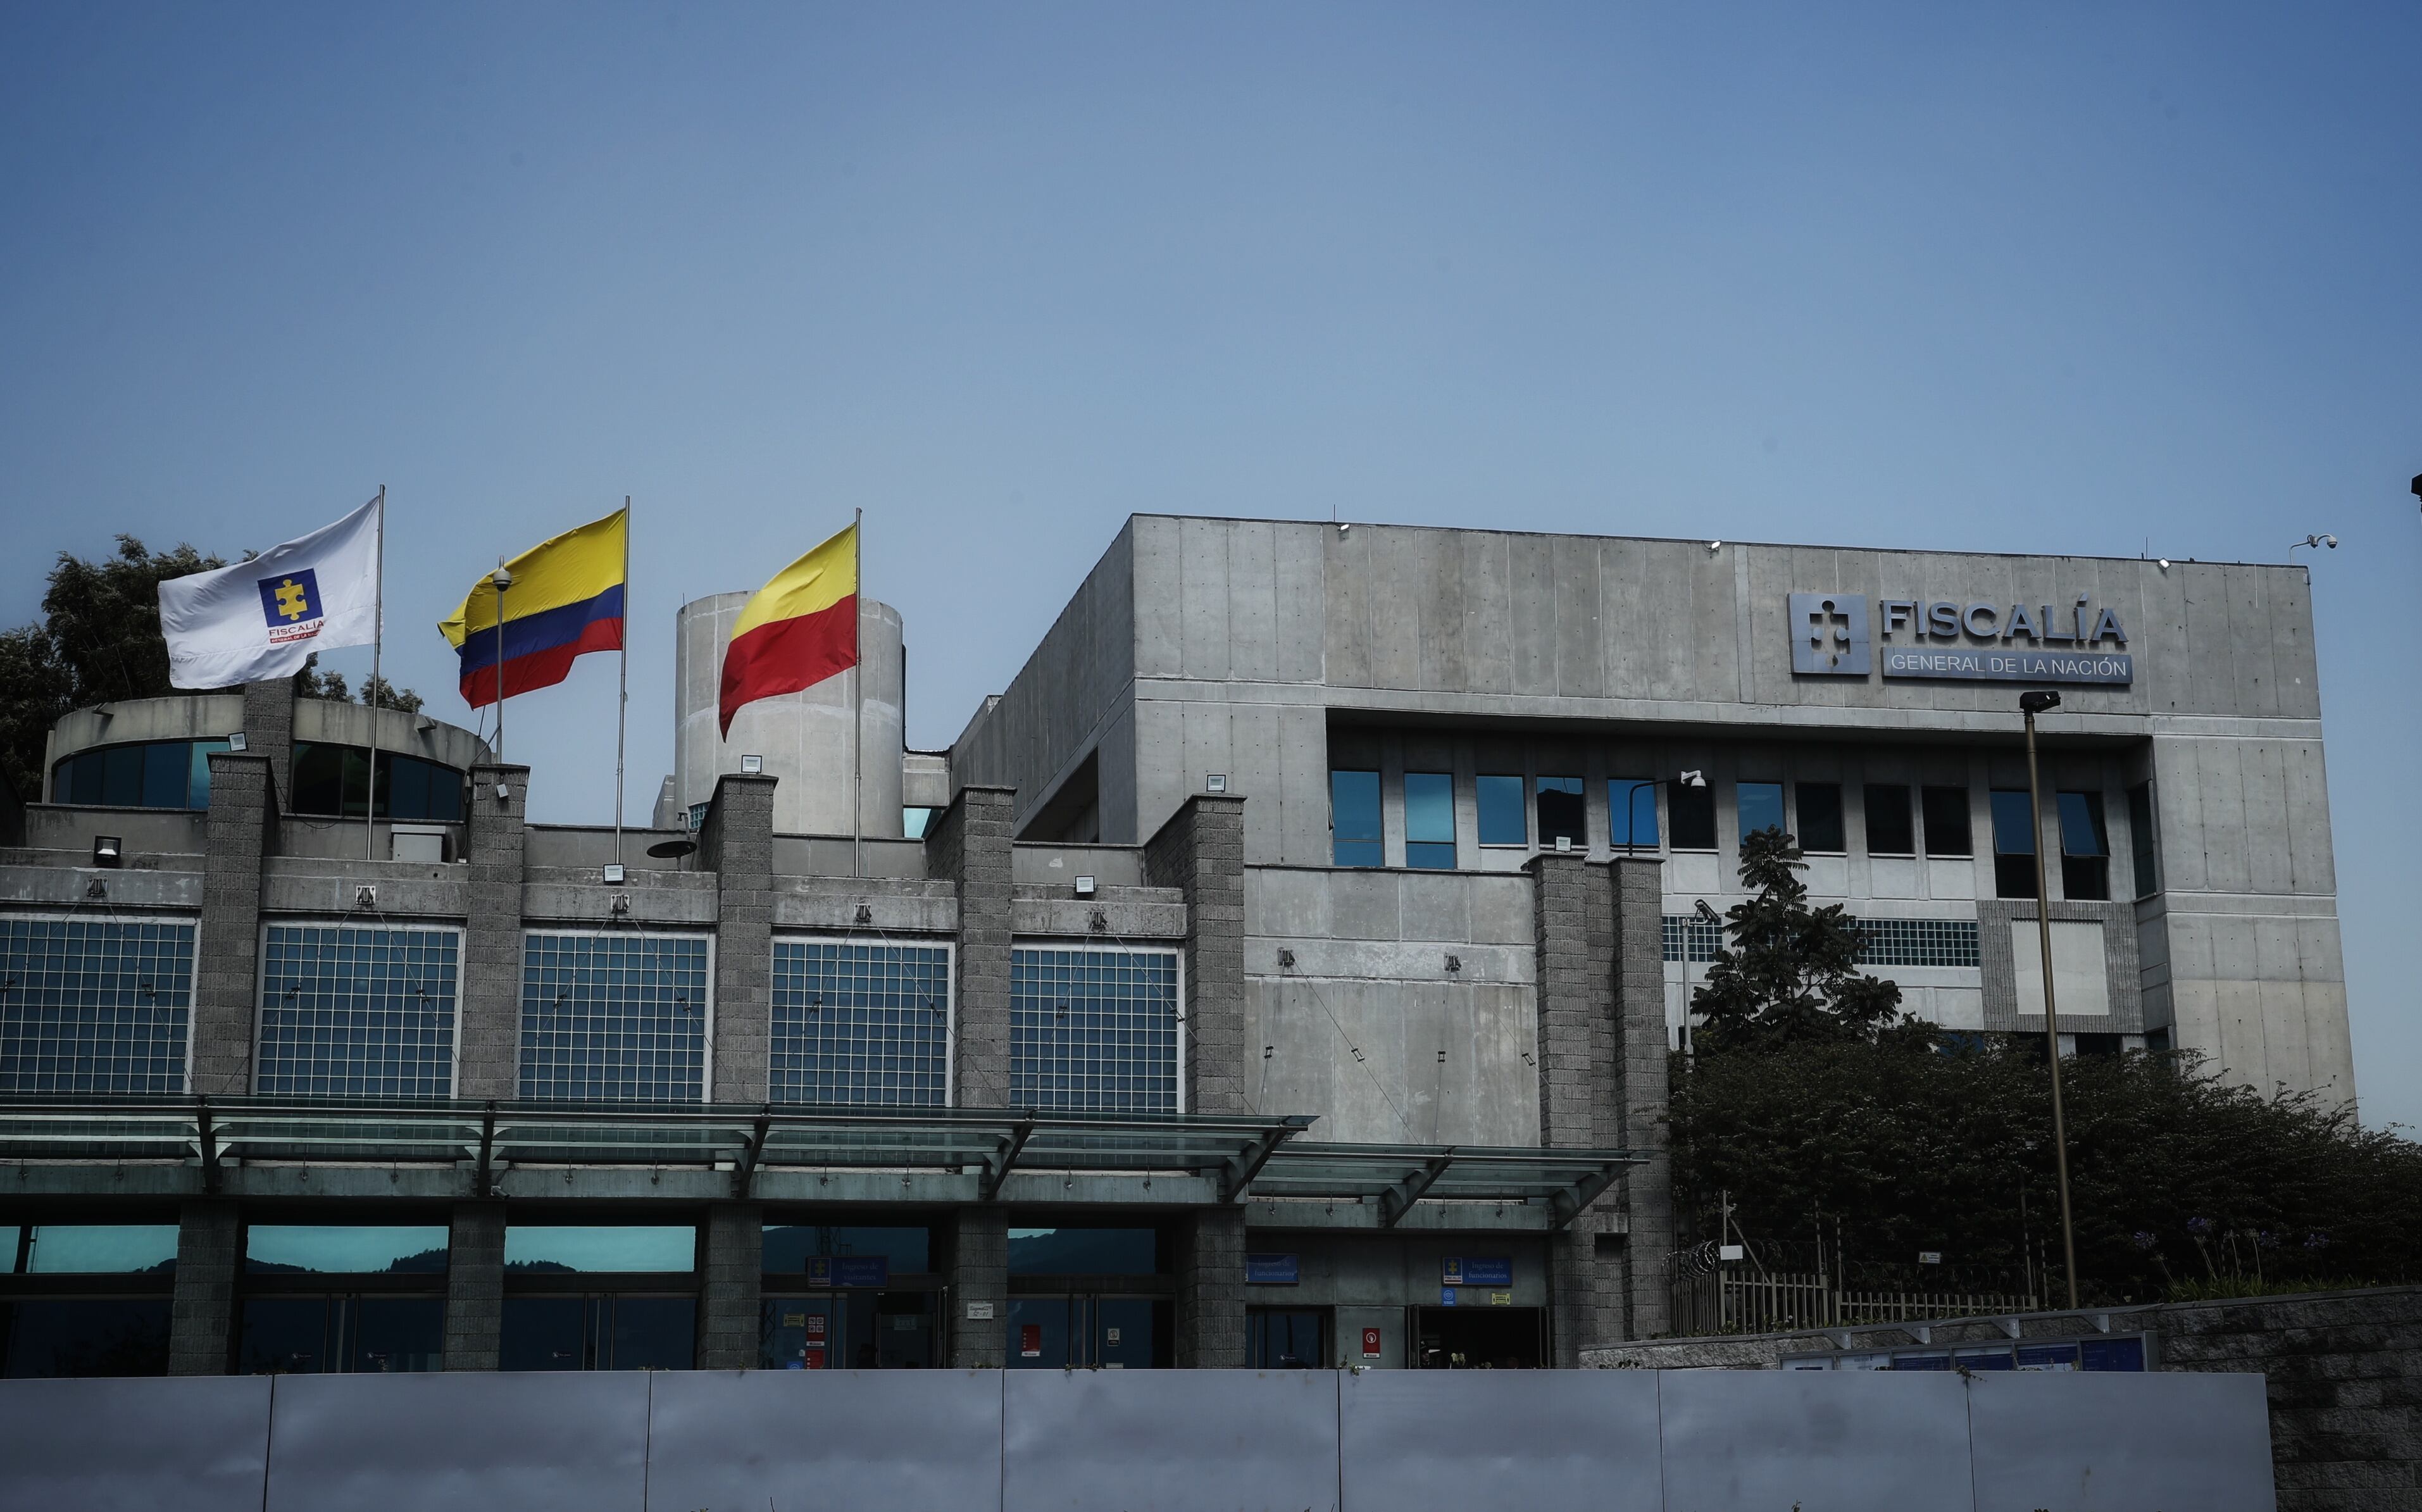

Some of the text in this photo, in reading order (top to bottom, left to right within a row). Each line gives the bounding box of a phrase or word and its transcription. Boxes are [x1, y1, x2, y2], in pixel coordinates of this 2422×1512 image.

[269, 620, 324, 636] FISCALÍA
[1881, 592, 2128, 642] FISCALÍA
[1891, 654, 2126, 676] GENERAL DE LA NACIÓN
